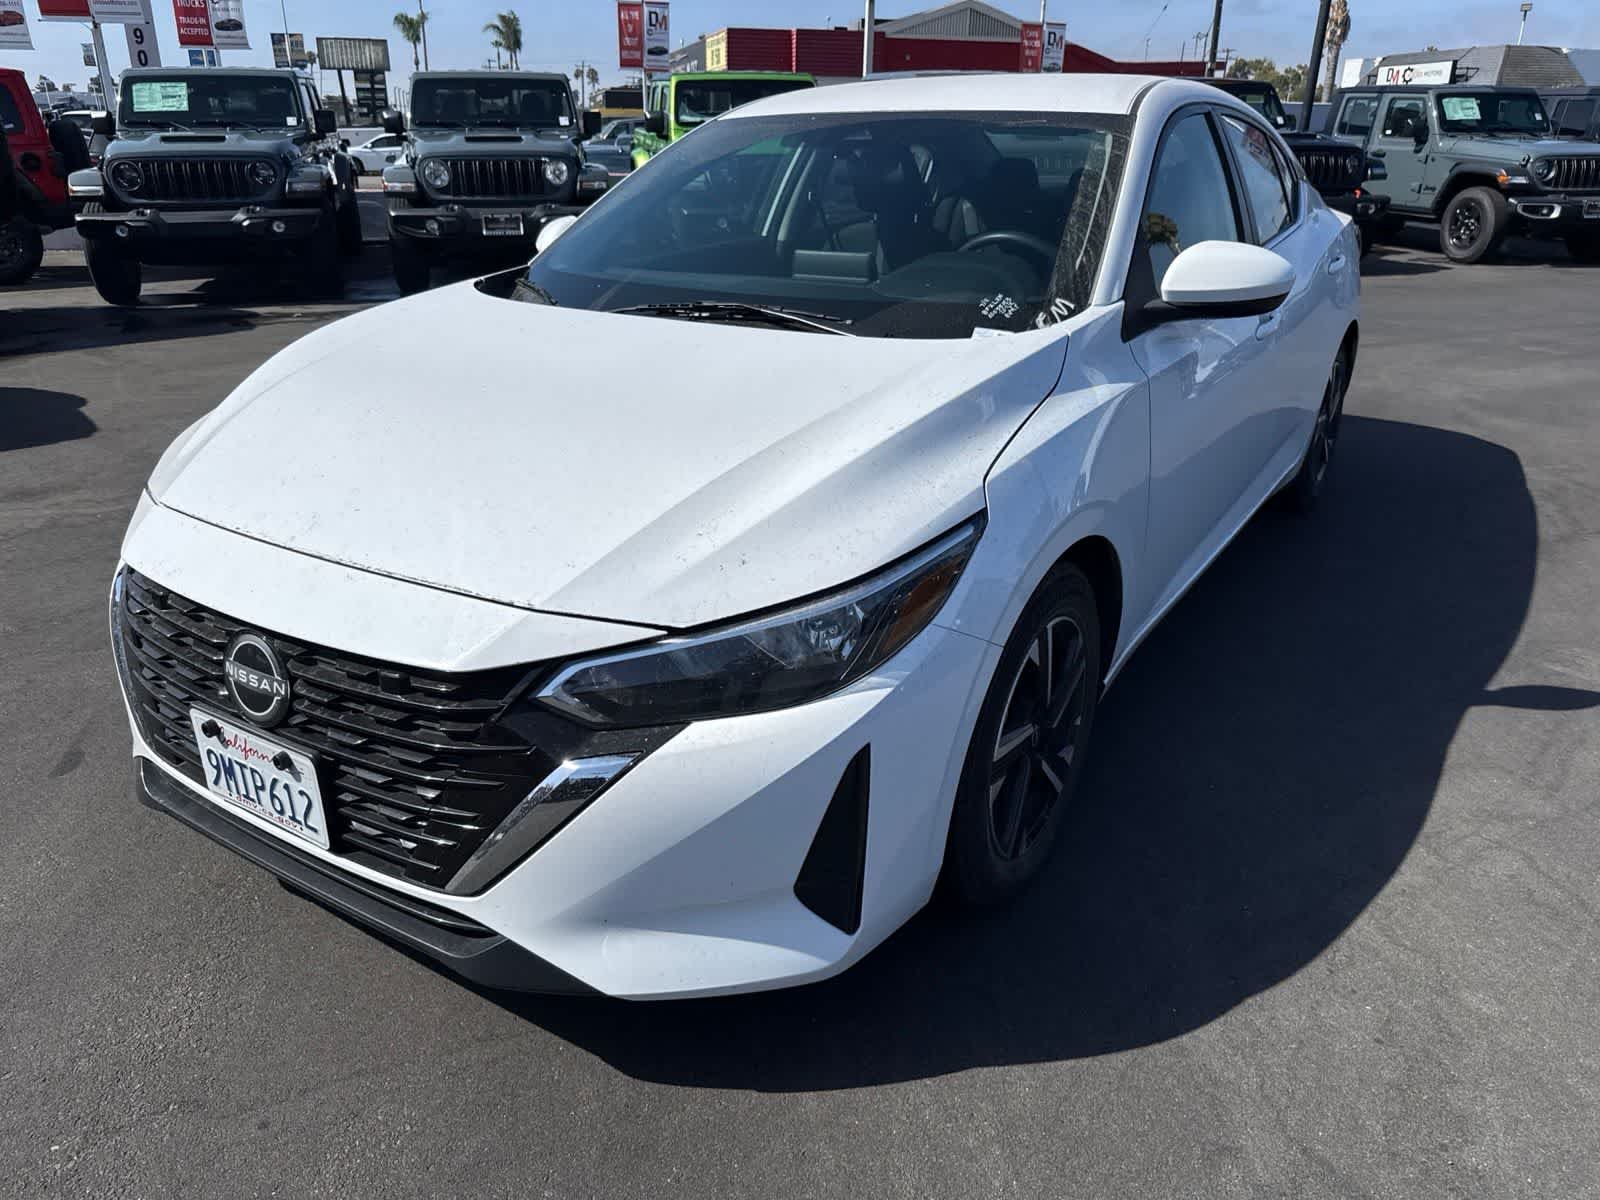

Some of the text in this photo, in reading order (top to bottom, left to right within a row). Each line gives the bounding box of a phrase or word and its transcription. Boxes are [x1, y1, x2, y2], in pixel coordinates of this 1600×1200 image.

[177, 0, 205, 8] TRUCKS
[179, 16, 206, 25] TRADE-IN
[649, 10, 668, 31] DM
[180, 27, 209, 36] ACCEPTED
[225, 661, 285, 695] NISSAN
[206, 748, 319, 834] 9MIP612
